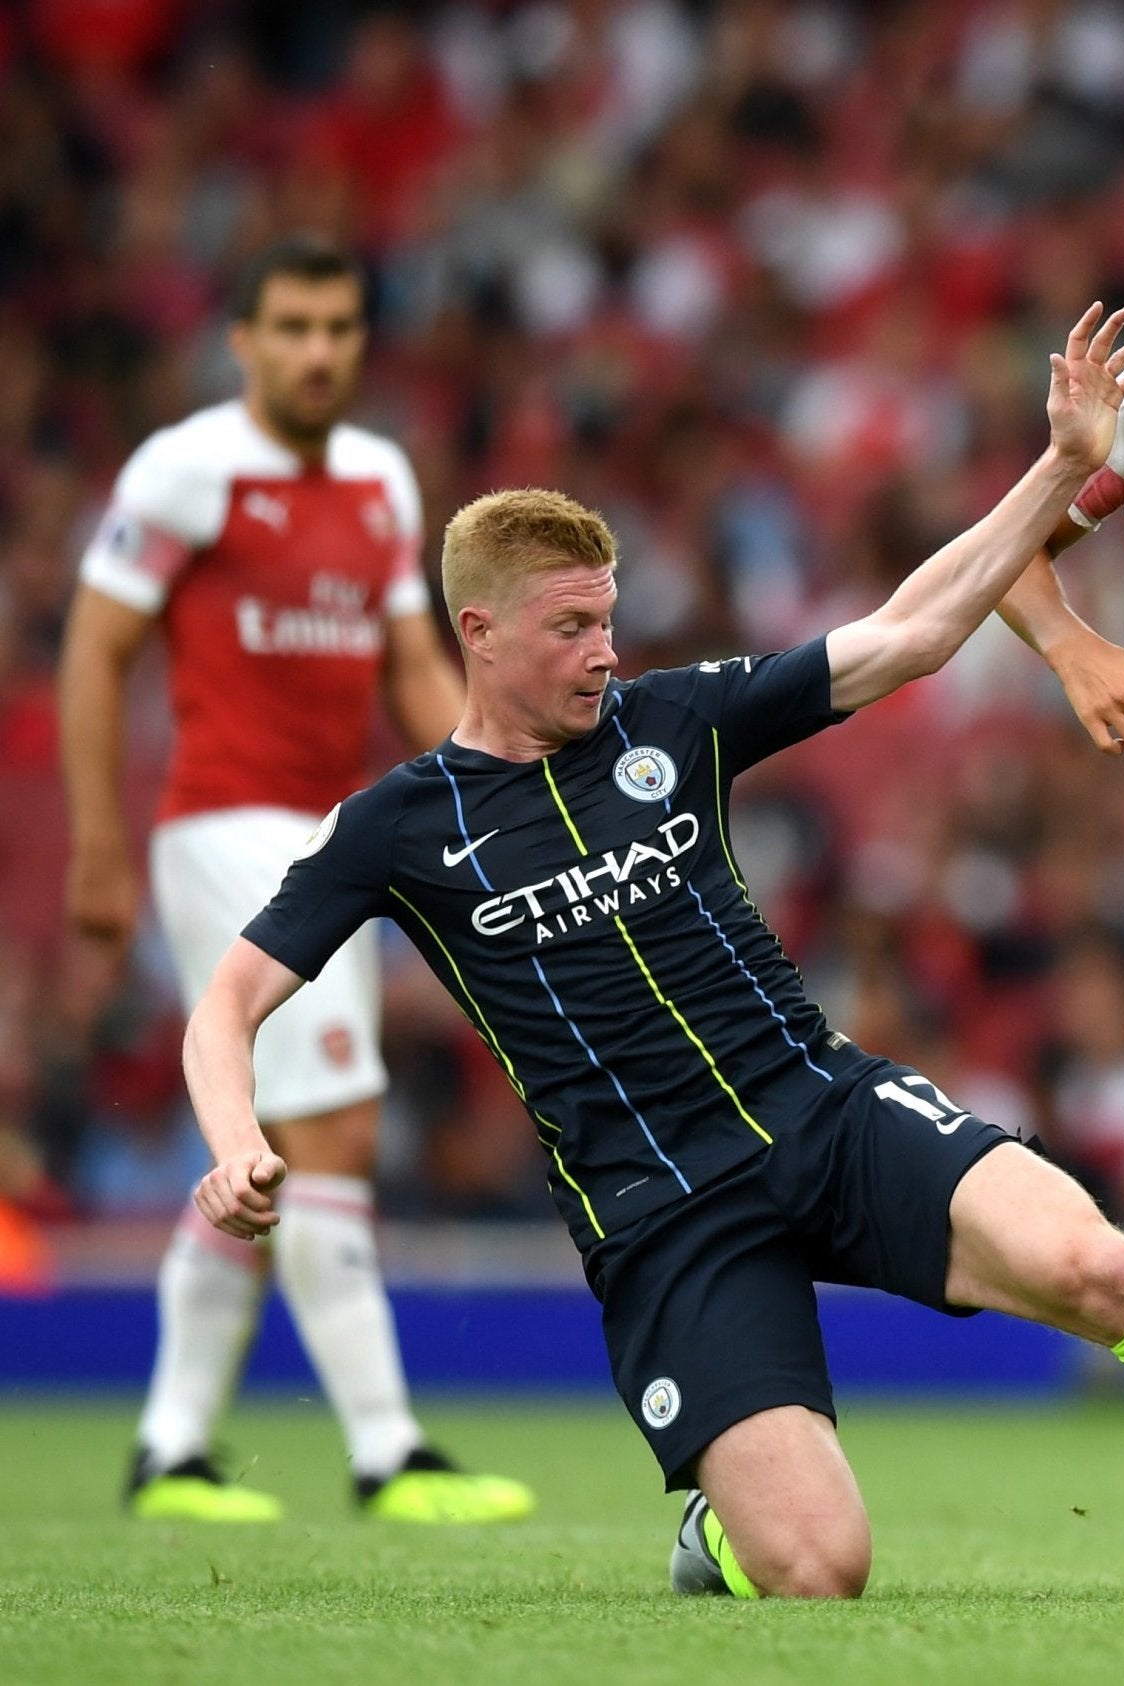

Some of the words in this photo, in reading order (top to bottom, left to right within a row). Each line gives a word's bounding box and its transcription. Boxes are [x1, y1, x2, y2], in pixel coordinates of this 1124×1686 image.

[617, 749, 661, 777] MANCHESTER
[651, 787, 667, 799] CITY
[471, 812, 699, 936] ETIHAD
[535, 866, 681, 944] AIRWAYS
